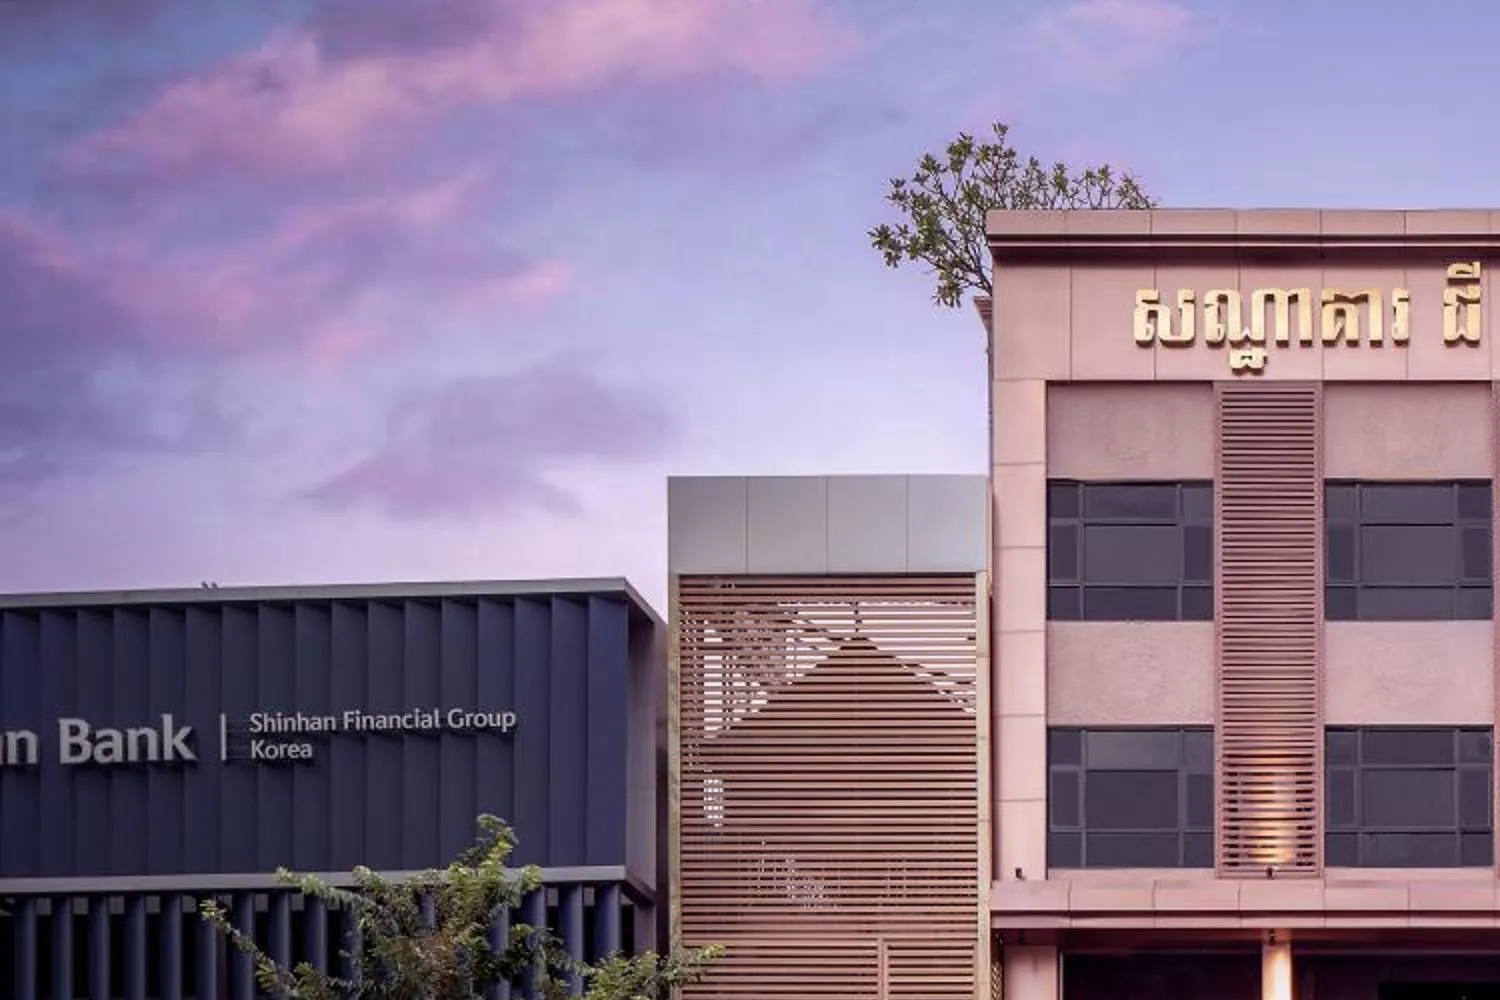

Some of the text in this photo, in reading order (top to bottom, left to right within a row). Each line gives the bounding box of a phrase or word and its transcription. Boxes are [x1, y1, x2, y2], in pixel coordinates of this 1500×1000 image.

[249, 708, 516, 734] Shinhan Financial Group
[0, 712, 198, 765] n Bank
[250, 739, 313, 761] Korea
